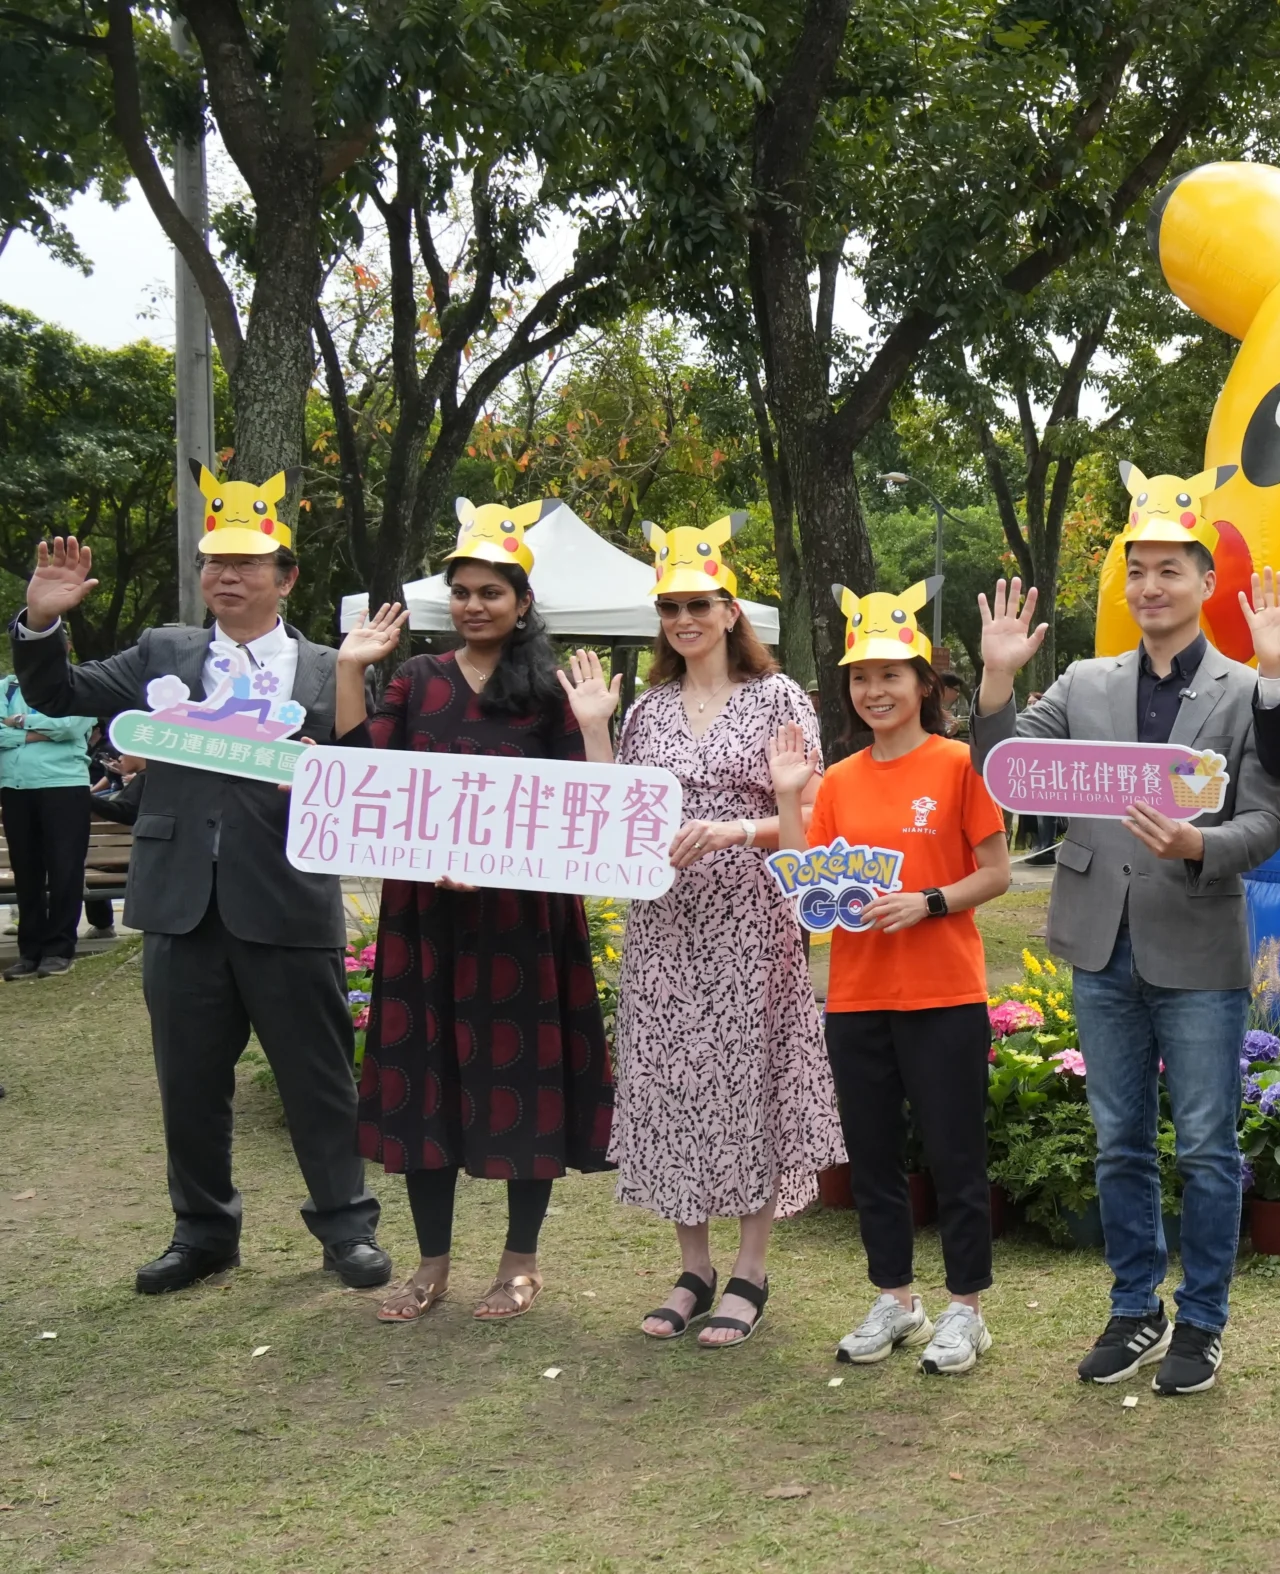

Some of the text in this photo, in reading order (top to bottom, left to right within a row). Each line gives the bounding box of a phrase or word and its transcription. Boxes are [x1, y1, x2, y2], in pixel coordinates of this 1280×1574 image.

[131, 723, 299, 772] 美力運動野餐區
[1006, 757, 1026, 778] 20
[302, 758, 346, 808] 20
[1008, 778, 1027, 799] 26
[1028, 759, 1163, 796] 台北花伴野餐
[1031, 790, 1068, 801] TAIPEI
[1073, 792, 1117, 804] FLORAL
[351, 764, 670, 861] 台北花伴野餐
[902, 827, 937, 835] NIANTIC
[297, 811, 340, 862] 26
[346, 842, 664, 888] TAIPEI FLORAL PICNIC
[800, 886, 876, 929] GO
